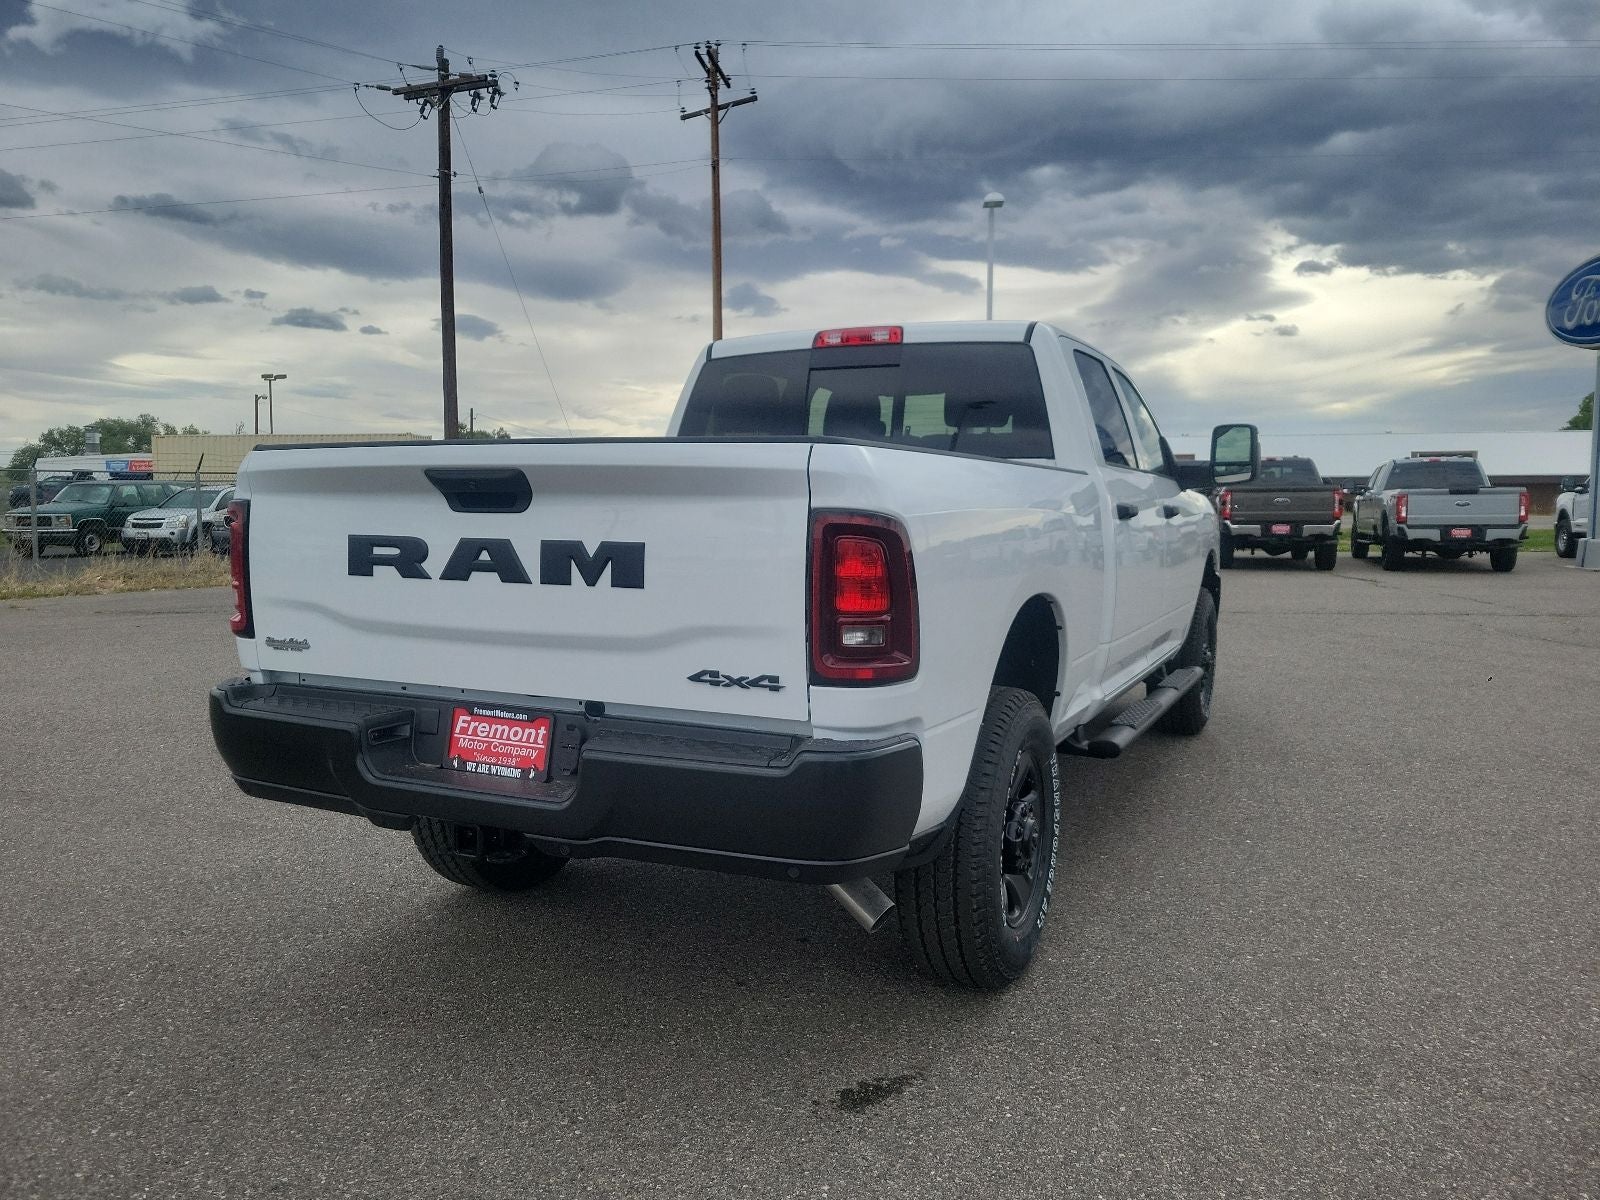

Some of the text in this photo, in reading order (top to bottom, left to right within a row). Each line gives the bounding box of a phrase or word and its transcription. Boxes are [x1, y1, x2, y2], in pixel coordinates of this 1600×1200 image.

[1564, 274, 1600, 330] Fo
[347, 534, 646, 589] RAM
[473, 707, 528, 720] FremontMotors.com
[455, 715, 546, 744] Fremont
[458, 738, 539, 759] Motor Company
[466, 761, 521, 778] WE ARE WYOMING
